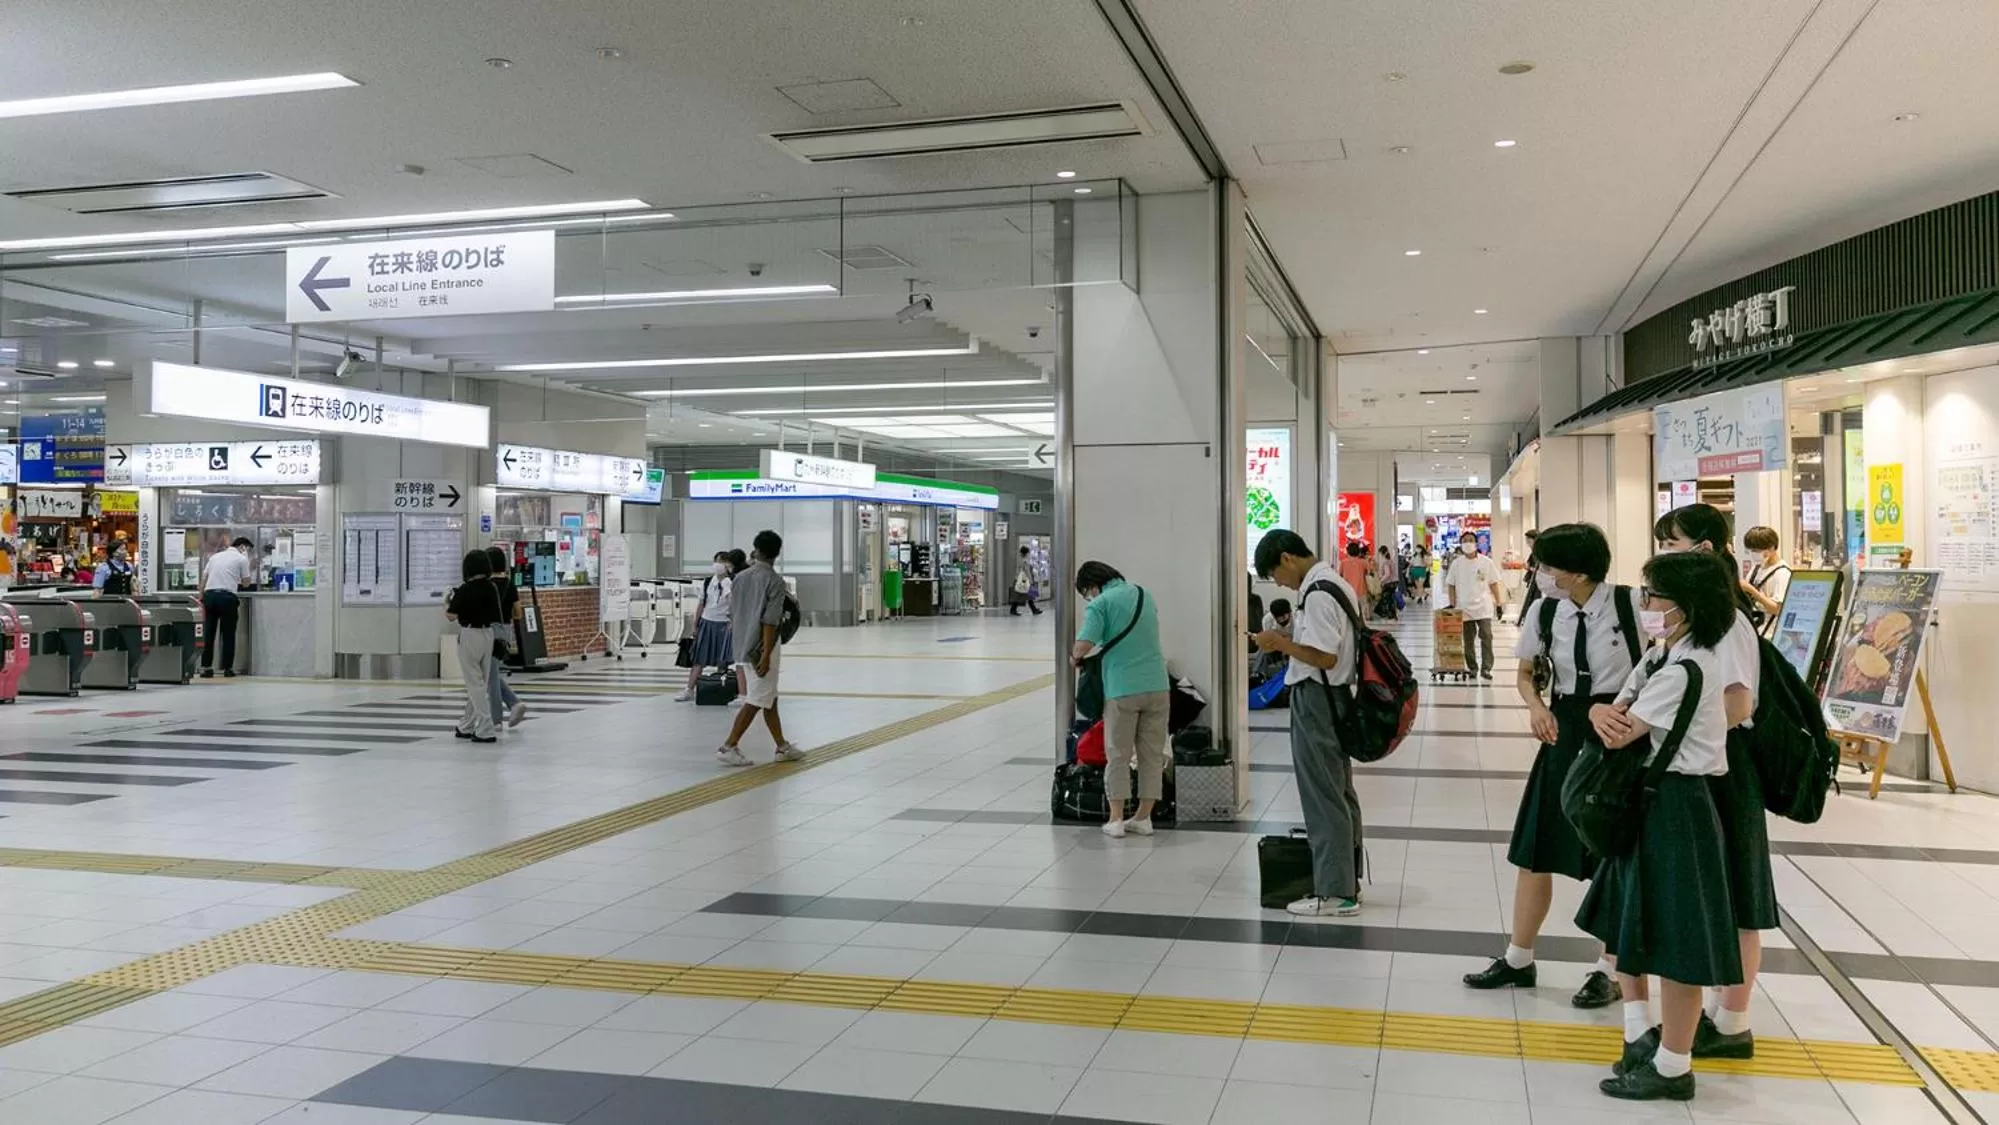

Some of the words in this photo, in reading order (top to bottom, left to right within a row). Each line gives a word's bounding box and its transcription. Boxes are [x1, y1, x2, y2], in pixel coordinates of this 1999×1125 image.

[368, 244, 506, 276] 在来線のりば
[367, 282, 398, 293] Local
[402, 280, 426, 292] Line
[431, 278, 484, 290] Entrance
[1689, 286, 1797, 351] みやげ横丁
[291, 394, 385, 424] 在来線のりば
[1694, 406, 1743, 454] 夏ギフト
[145, 447, 204, 459] うらが白色の
[277, 444, 313, 458] 在来線
[395, 482, 435, 495] 新幹線
[746, 483, 797, 494] FamilyMart
[394, 496, 434, 508] のりば
